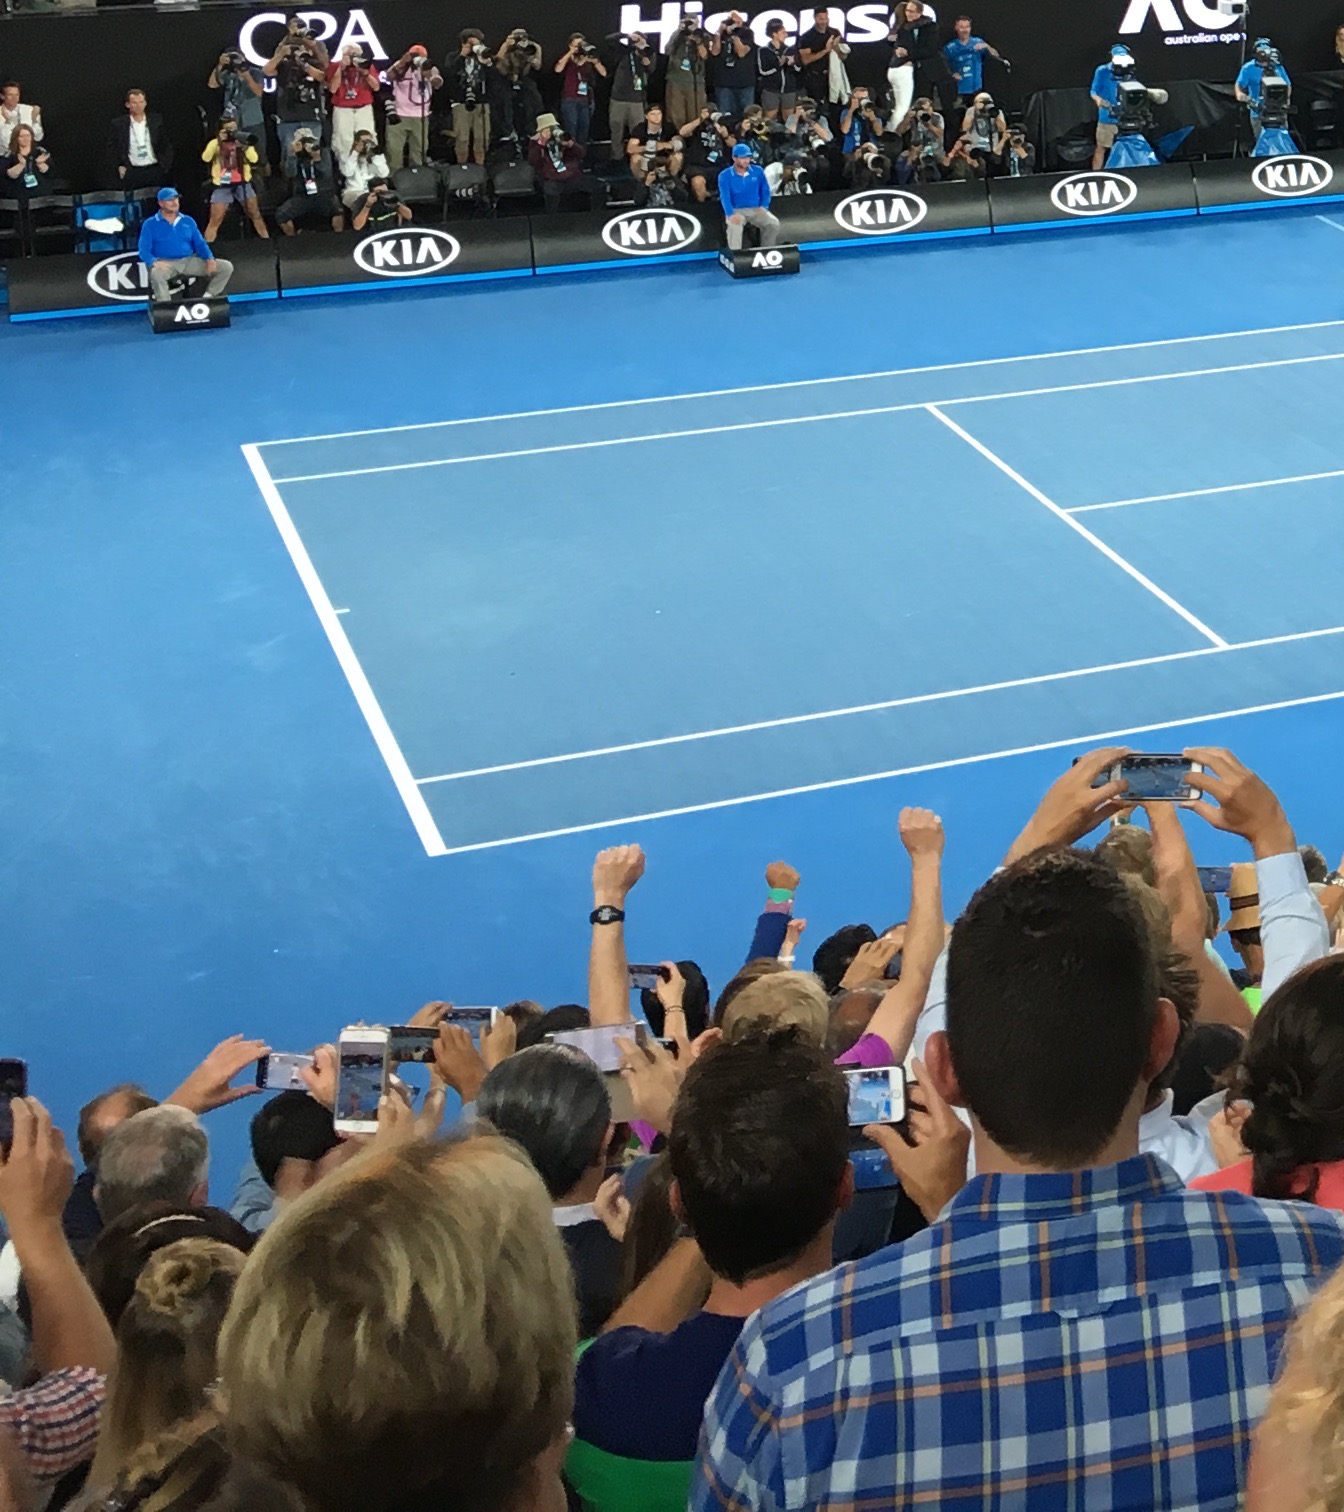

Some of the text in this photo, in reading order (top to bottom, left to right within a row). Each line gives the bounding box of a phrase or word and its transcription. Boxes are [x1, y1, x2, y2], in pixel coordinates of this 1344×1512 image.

[1164, 32, 1218, 46] australian
[1265, 164, 1321, 188] KIA
[1066, 180, 1124, 207] KIA
[849, 196, 912, 225] KIA
[619, 217, 684, 246] KIA
[371, 238, 443, 268] KIA
[752, 250, 783, 268] AO
[174, 303, 210, 322] AO
